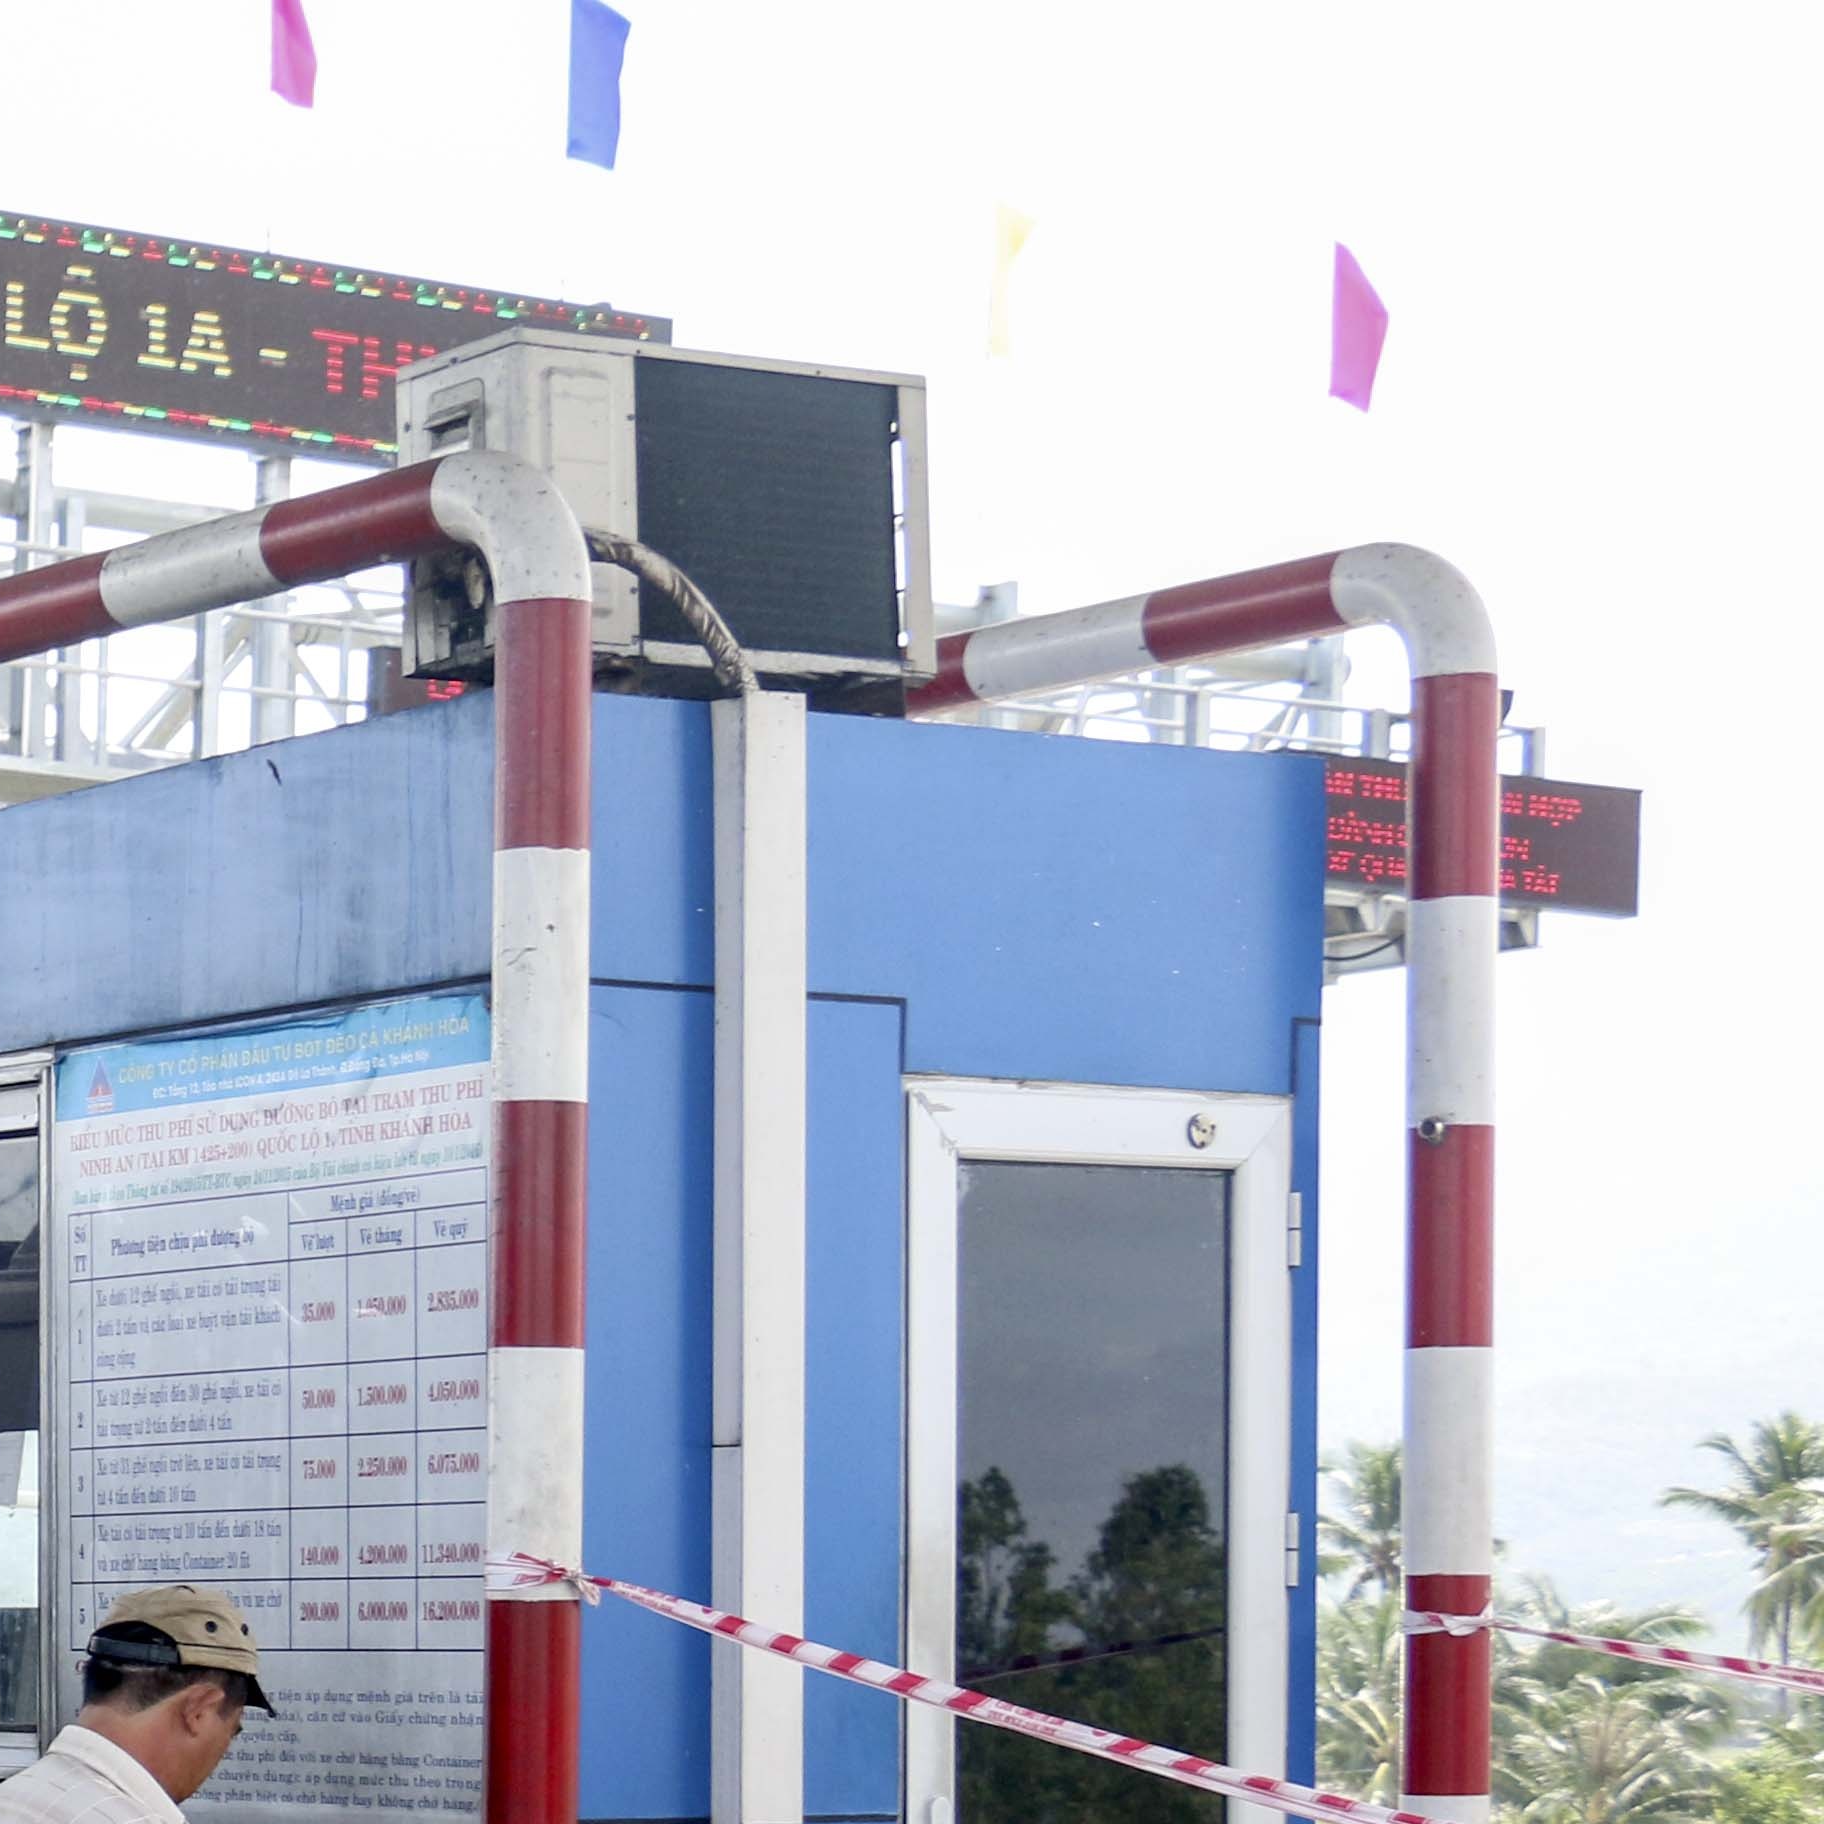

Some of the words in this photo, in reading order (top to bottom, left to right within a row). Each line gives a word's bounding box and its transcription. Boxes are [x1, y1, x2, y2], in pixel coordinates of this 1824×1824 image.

[4, 264, 109, 382] LỘ
[138, 303, 234, 379] 1A
[159, 1061, 175, 1078] TY
[137, 1121, 164, 1143] THU
[419, 1082, 453, 1106] THU
[167, 1146, 189, 1167] KM
[302, 1301, 336, 1323] 35.000
[302, 1388, 336, 1410] 50.000
[357, 1383, 407, 1407] 1.500.000
[428, 1378, 480, 1404] 4.050.000
[303, 1458, 337, 1480] 75.000
[357, 1456, 408, 1479] 2.250.000
[428, 1452, 480, 1476] 6.075.000
[300, 1544, 340, 1567] 140.000
[358, 1543, 408, 1566] 4.200.000
[421, 1542, 481, 1565] 11.340.000
[300, 1601, 340, 1622] 200.000
[358, 1601, 409, 1622] 6.000.000
[421, 1600, 481, 1622] 16.200.000
